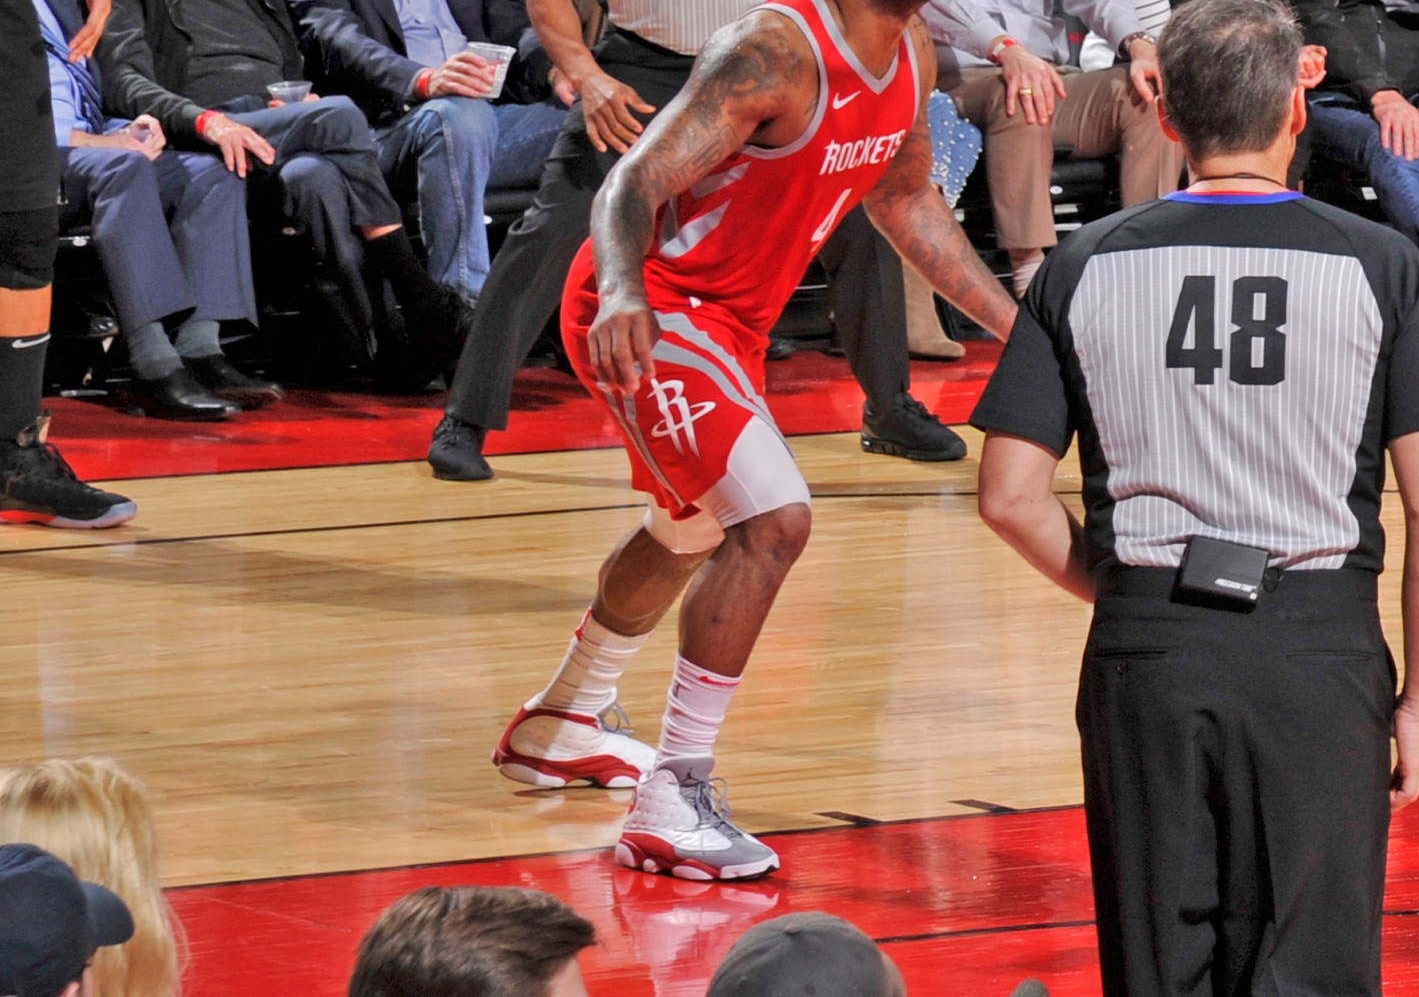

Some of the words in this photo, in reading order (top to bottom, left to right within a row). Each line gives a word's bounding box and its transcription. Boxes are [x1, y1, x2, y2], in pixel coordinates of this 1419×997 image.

[818, 129, 907, 176] ROCKETS
[810, 188, 853, 252] 4
[1165, 274, 1289, 386] 48
